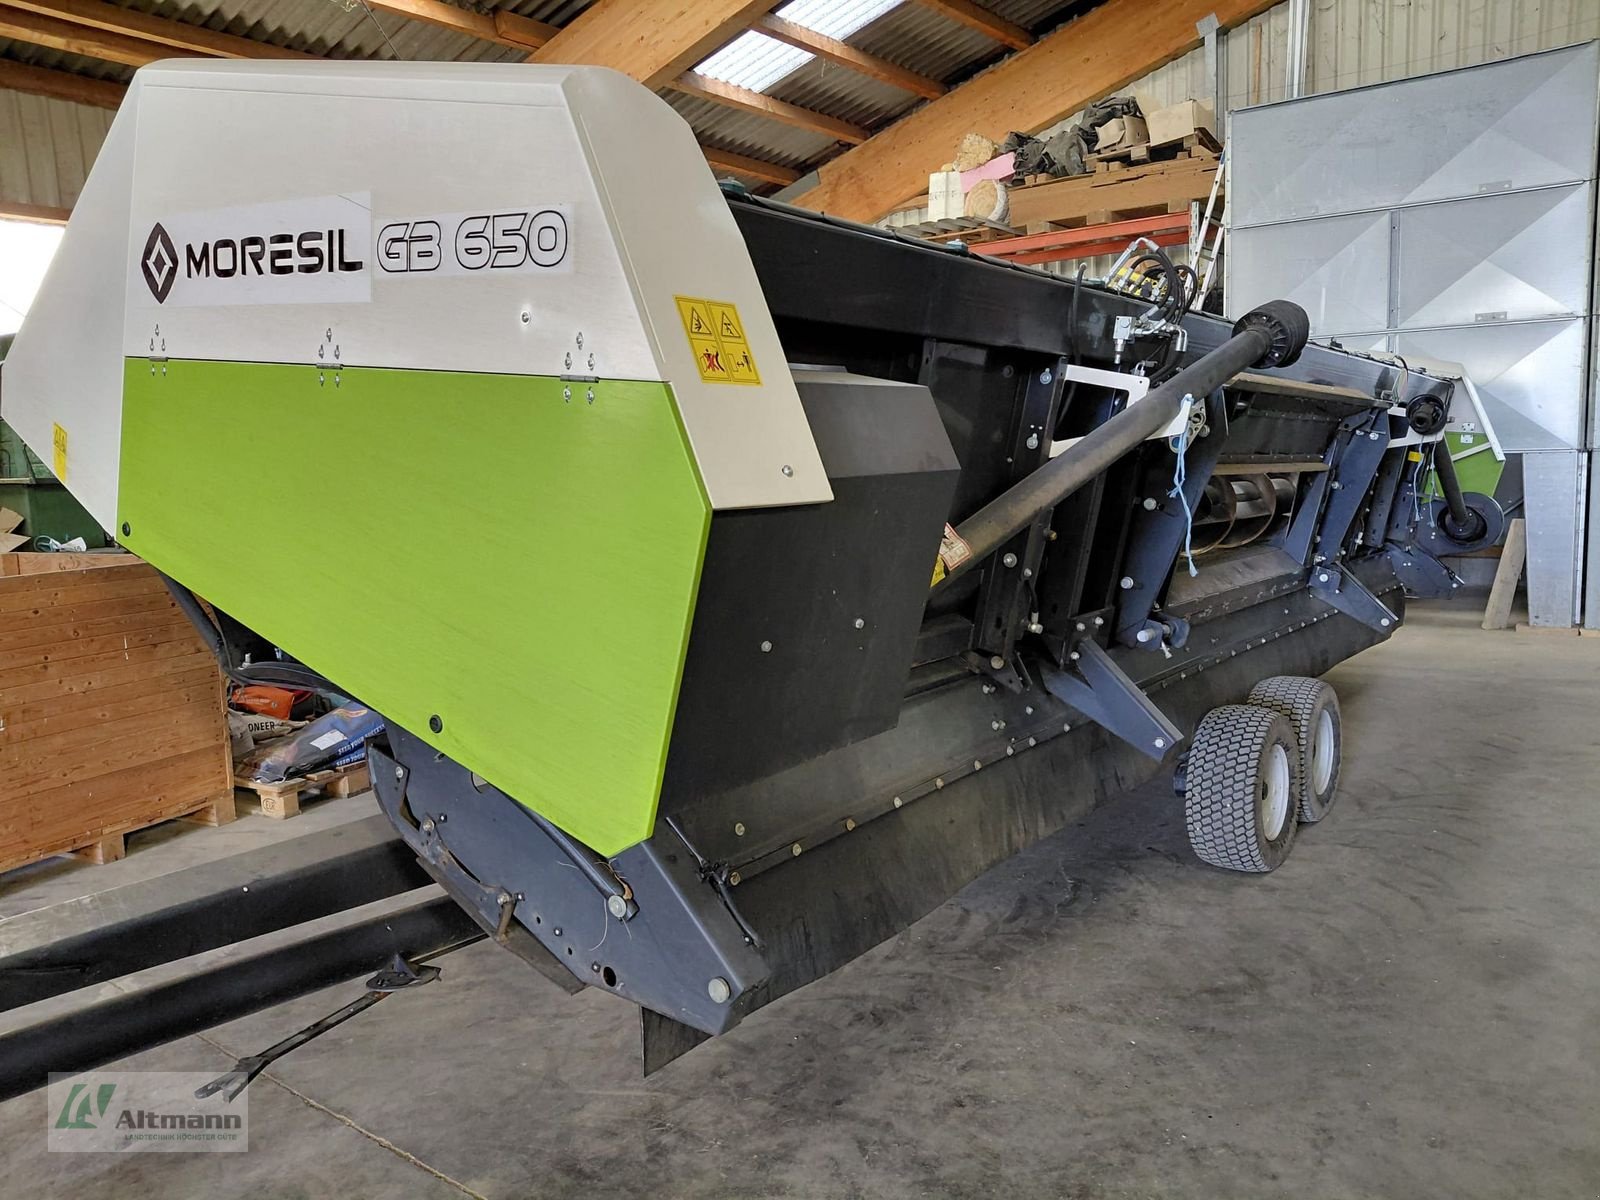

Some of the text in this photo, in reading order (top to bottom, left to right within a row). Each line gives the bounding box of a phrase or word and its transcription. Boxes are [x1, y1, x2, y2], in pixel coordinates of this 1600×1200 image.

[186, 210, 568, 278] MORESIL GB 650
